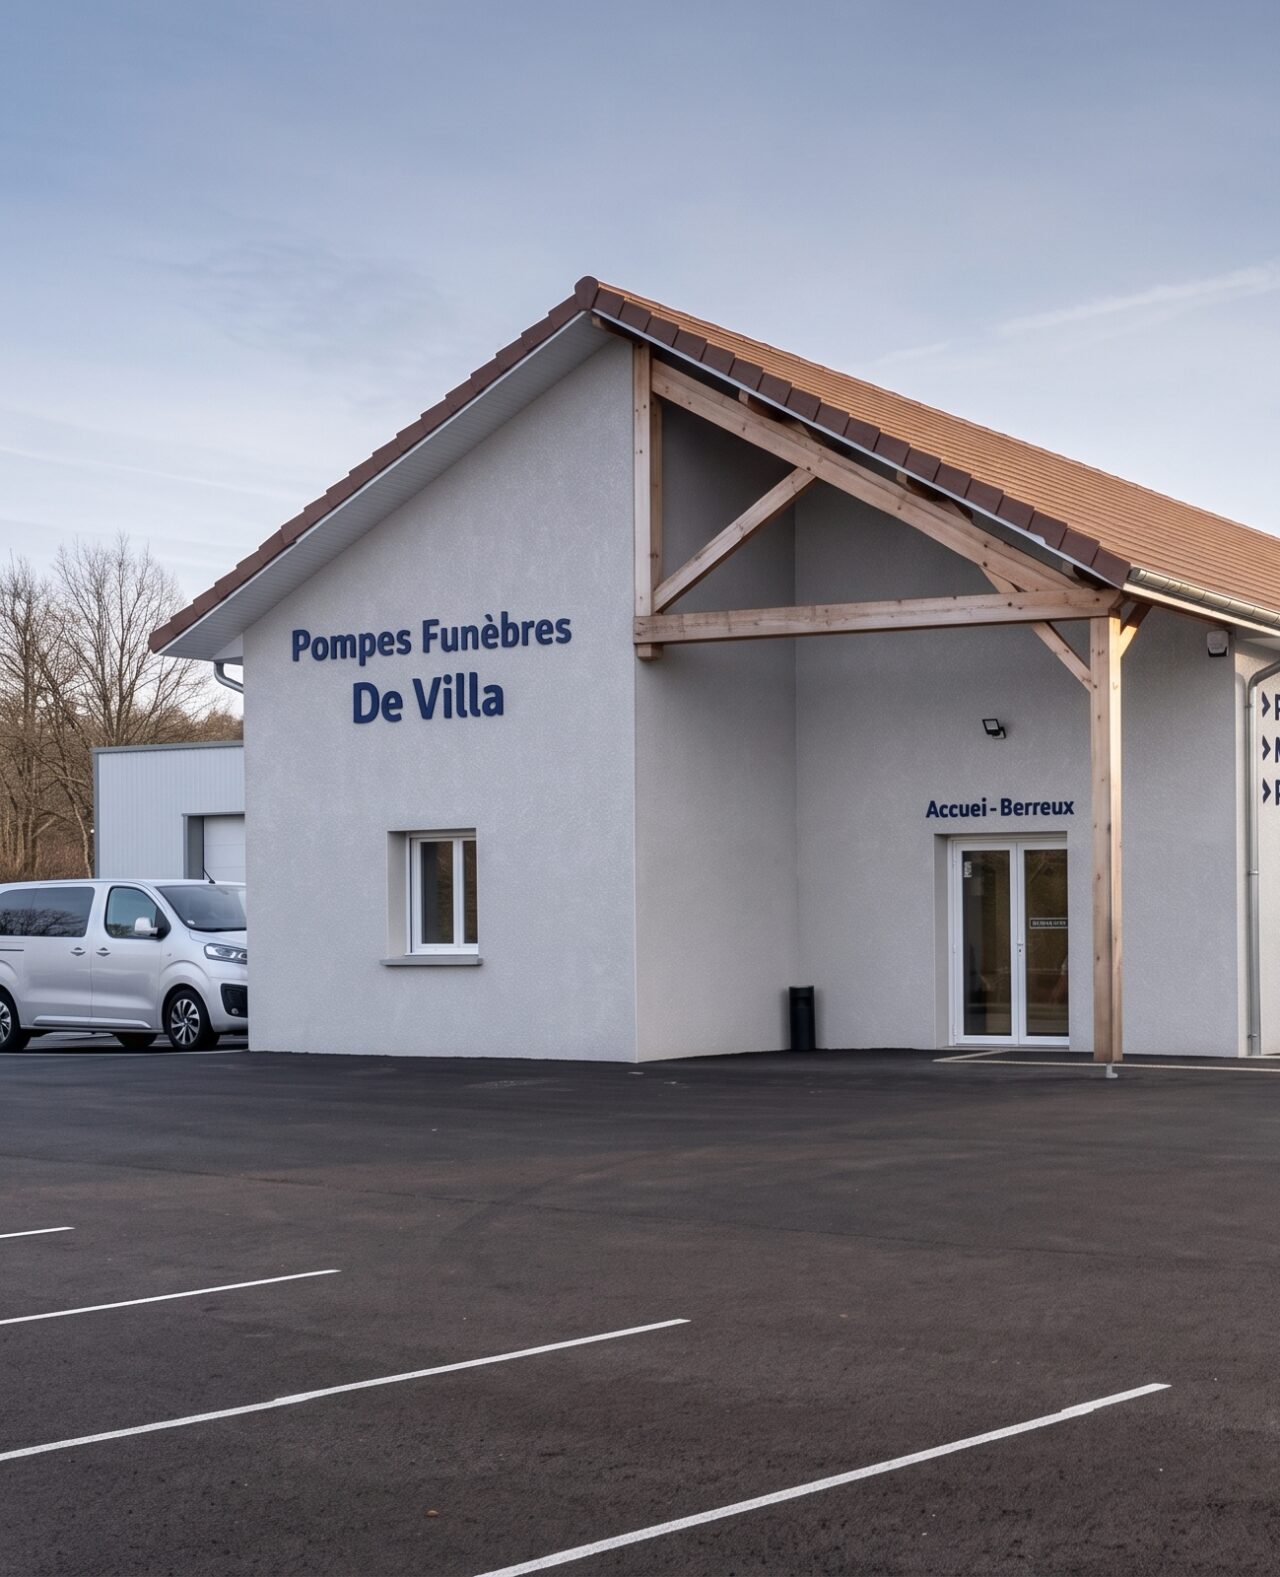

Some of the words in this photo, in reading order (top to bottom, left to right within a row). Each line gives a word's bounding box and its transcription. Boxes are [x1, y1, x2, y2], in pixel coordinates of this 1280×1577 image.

[292, 629, 412, 667] Pompes
[422, 610, 572, 654] Funèbres
[352, 681, 404, 725] De
[412, 671, 504, 721] Villa
